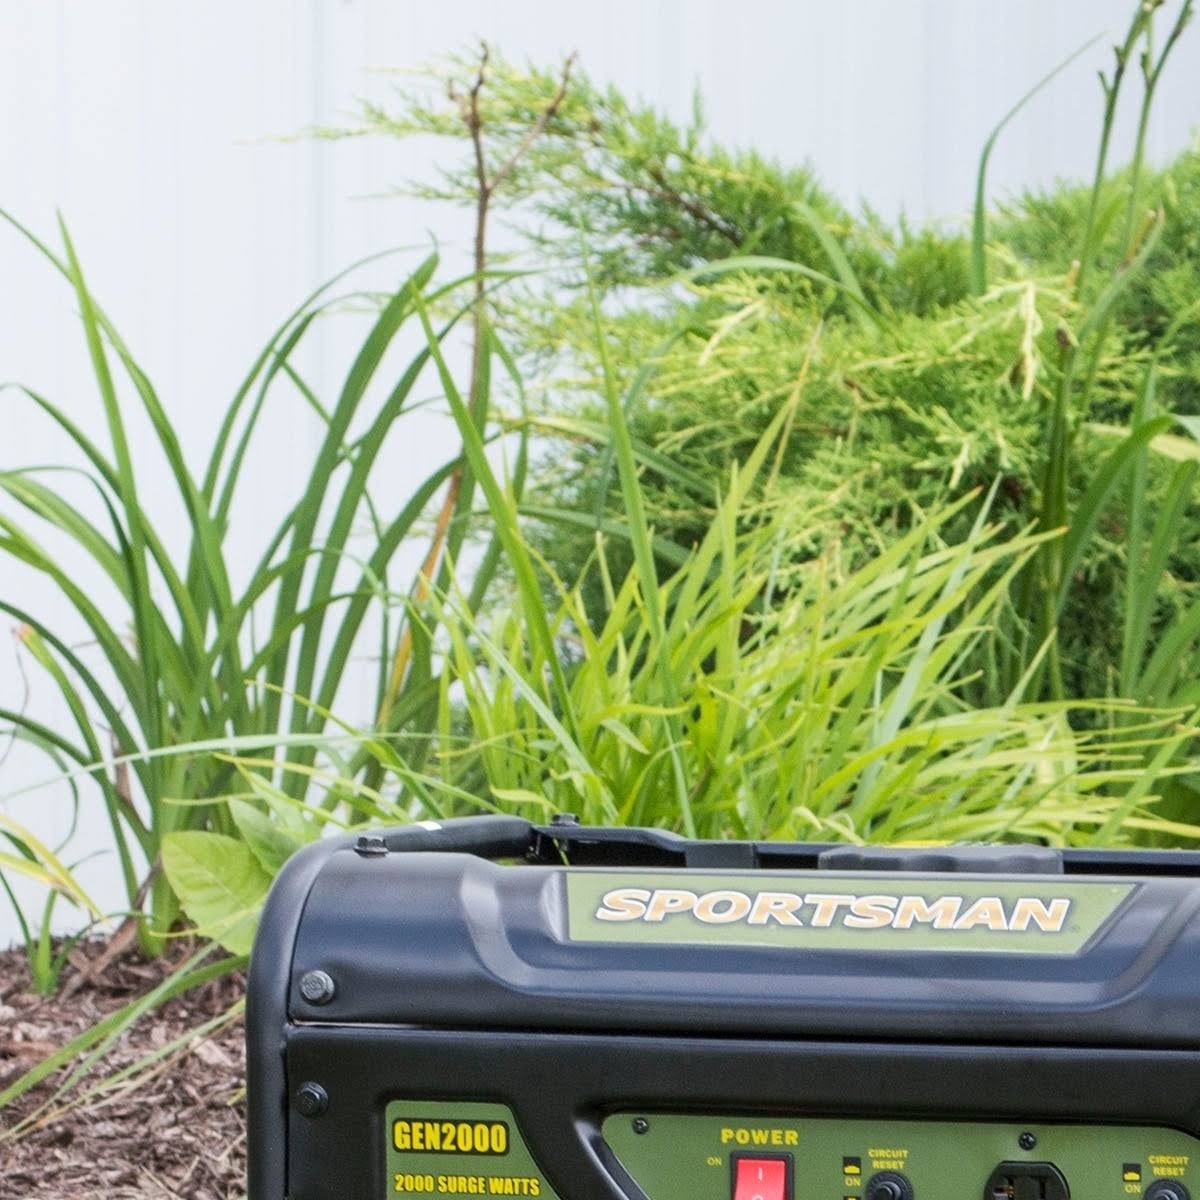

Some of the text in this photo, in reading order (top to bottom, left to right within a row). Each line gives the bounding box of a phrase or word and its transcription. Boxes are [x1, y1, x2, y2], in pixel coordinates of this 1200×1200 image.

[596, 888, 1070, 932] SPORTSMAN
[394, 1121, 507, 1152] GEN2000
[721, 1129, 799, 1145] POWER
[868, 1149, 909, 1158] CIRCUIT
[707, 1157, 722, 1167] ON
[1148, 1155, 1189, 1164] CIRCUIT
[872, 1161, 905, 1169] RESET
[1153, 1167, 1185, 1176] RESET
[395, 1174, 541, 1196] 2000 SURGE WATTS
[845, 1178, 861, 1187] ON
[1125, 1184, 1141, 1193] ON
